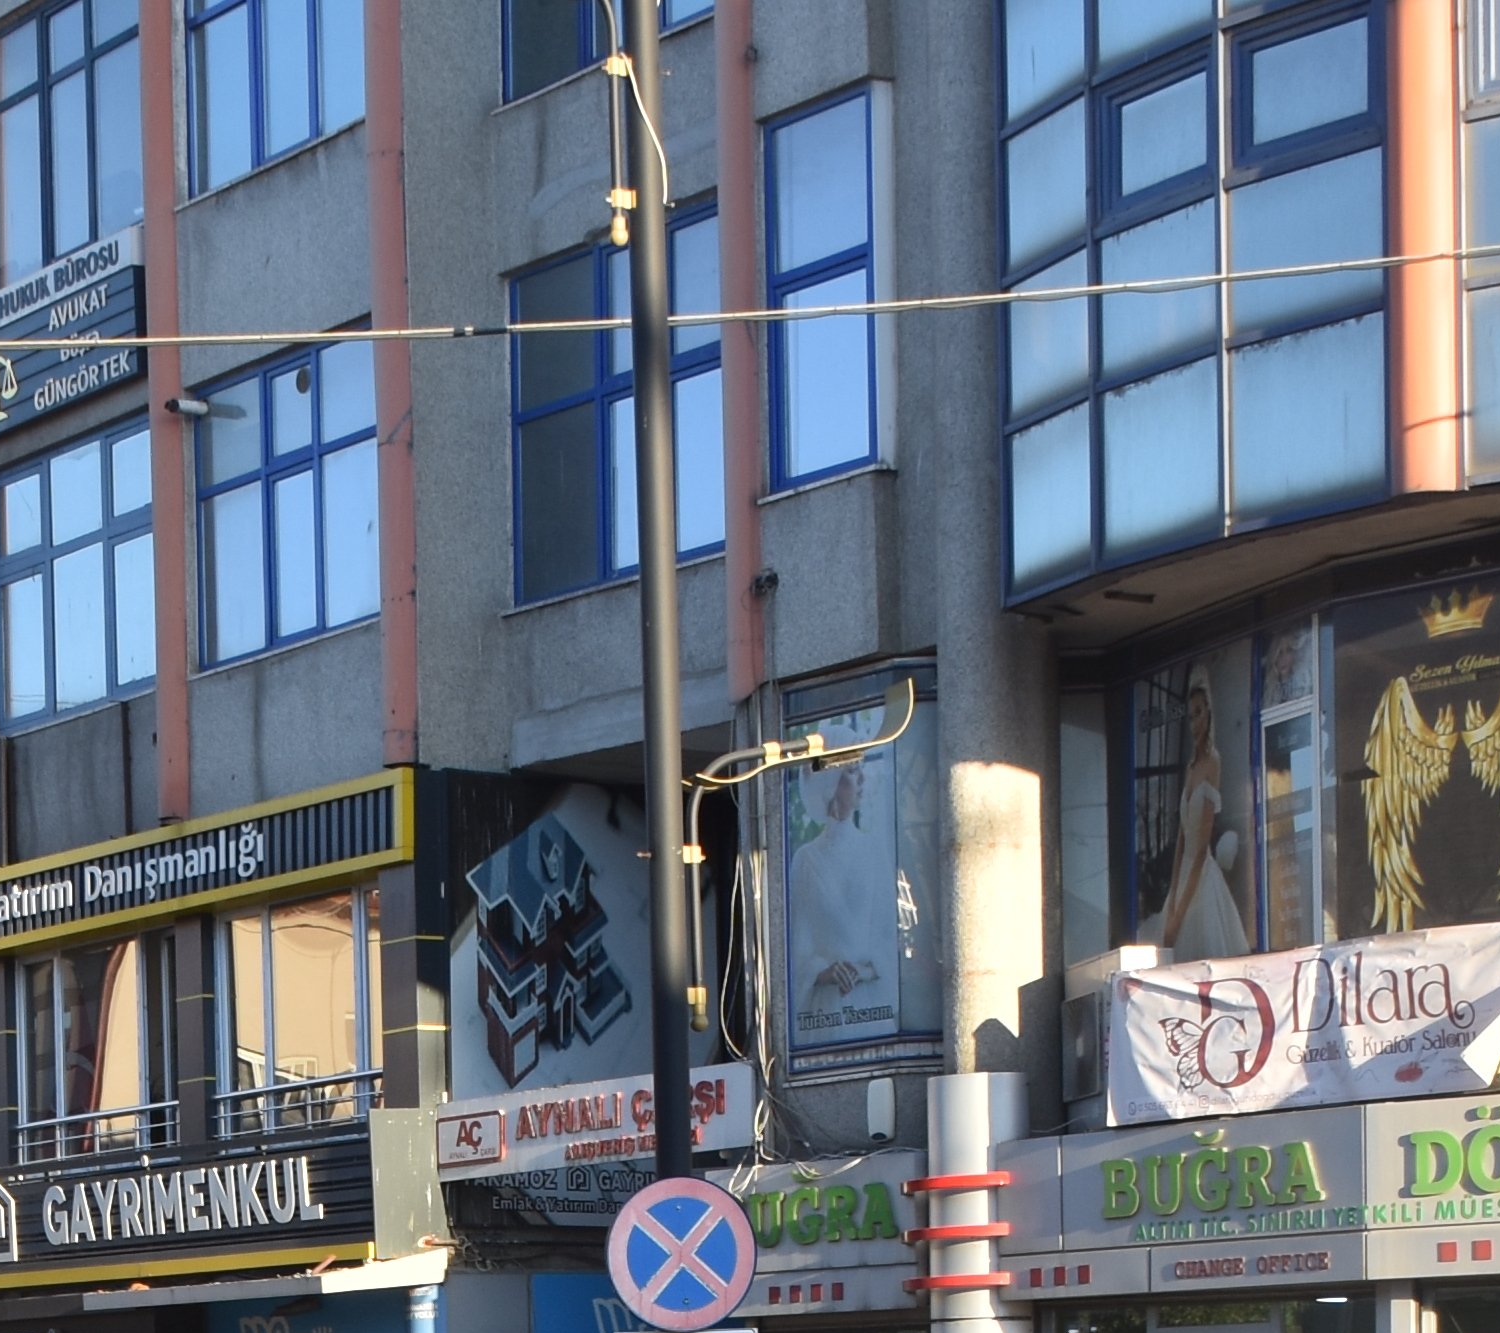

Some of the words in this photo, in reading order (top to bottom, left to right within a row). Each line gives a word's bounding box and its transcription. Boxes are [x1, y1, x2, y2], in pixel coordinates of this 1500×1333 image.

[0, 276, 50, 320] HUKUK
[54, 240, 119, 290] BÜROSU
[49, 284, 109, 332] AVUKAT
[34, 366, 99, 411] GÜNGÖR
[103, 351, 132, 385] TEK
[84, 822, 265, 902] Danışmanlığı
[798, 1010, 842, 1031] Turban
[1293, 951, 1476, 1034] Dilara
[1363, 1032, 1416, 1055] Kuaför
[1422, 1029, 1477, 1052] Salonu
[456, 1120, 483, 1154] AÇ
[515, 1091, 622, 1140] AYNALI
[631, 1079, 725, 1132] ÇŞI
[42, 1155, 324, 1247] GAYRİMENKUL
[1102, 1129, 1327, 1219] BUĞRA
[492, 1197, 533, 1212] Emlak
[748, 1169, 899, 1249] UĞRA
[1175, 1257, 1245, 1279] CHANGE
[1256, 1252, 1330, 1274] OFFICE
